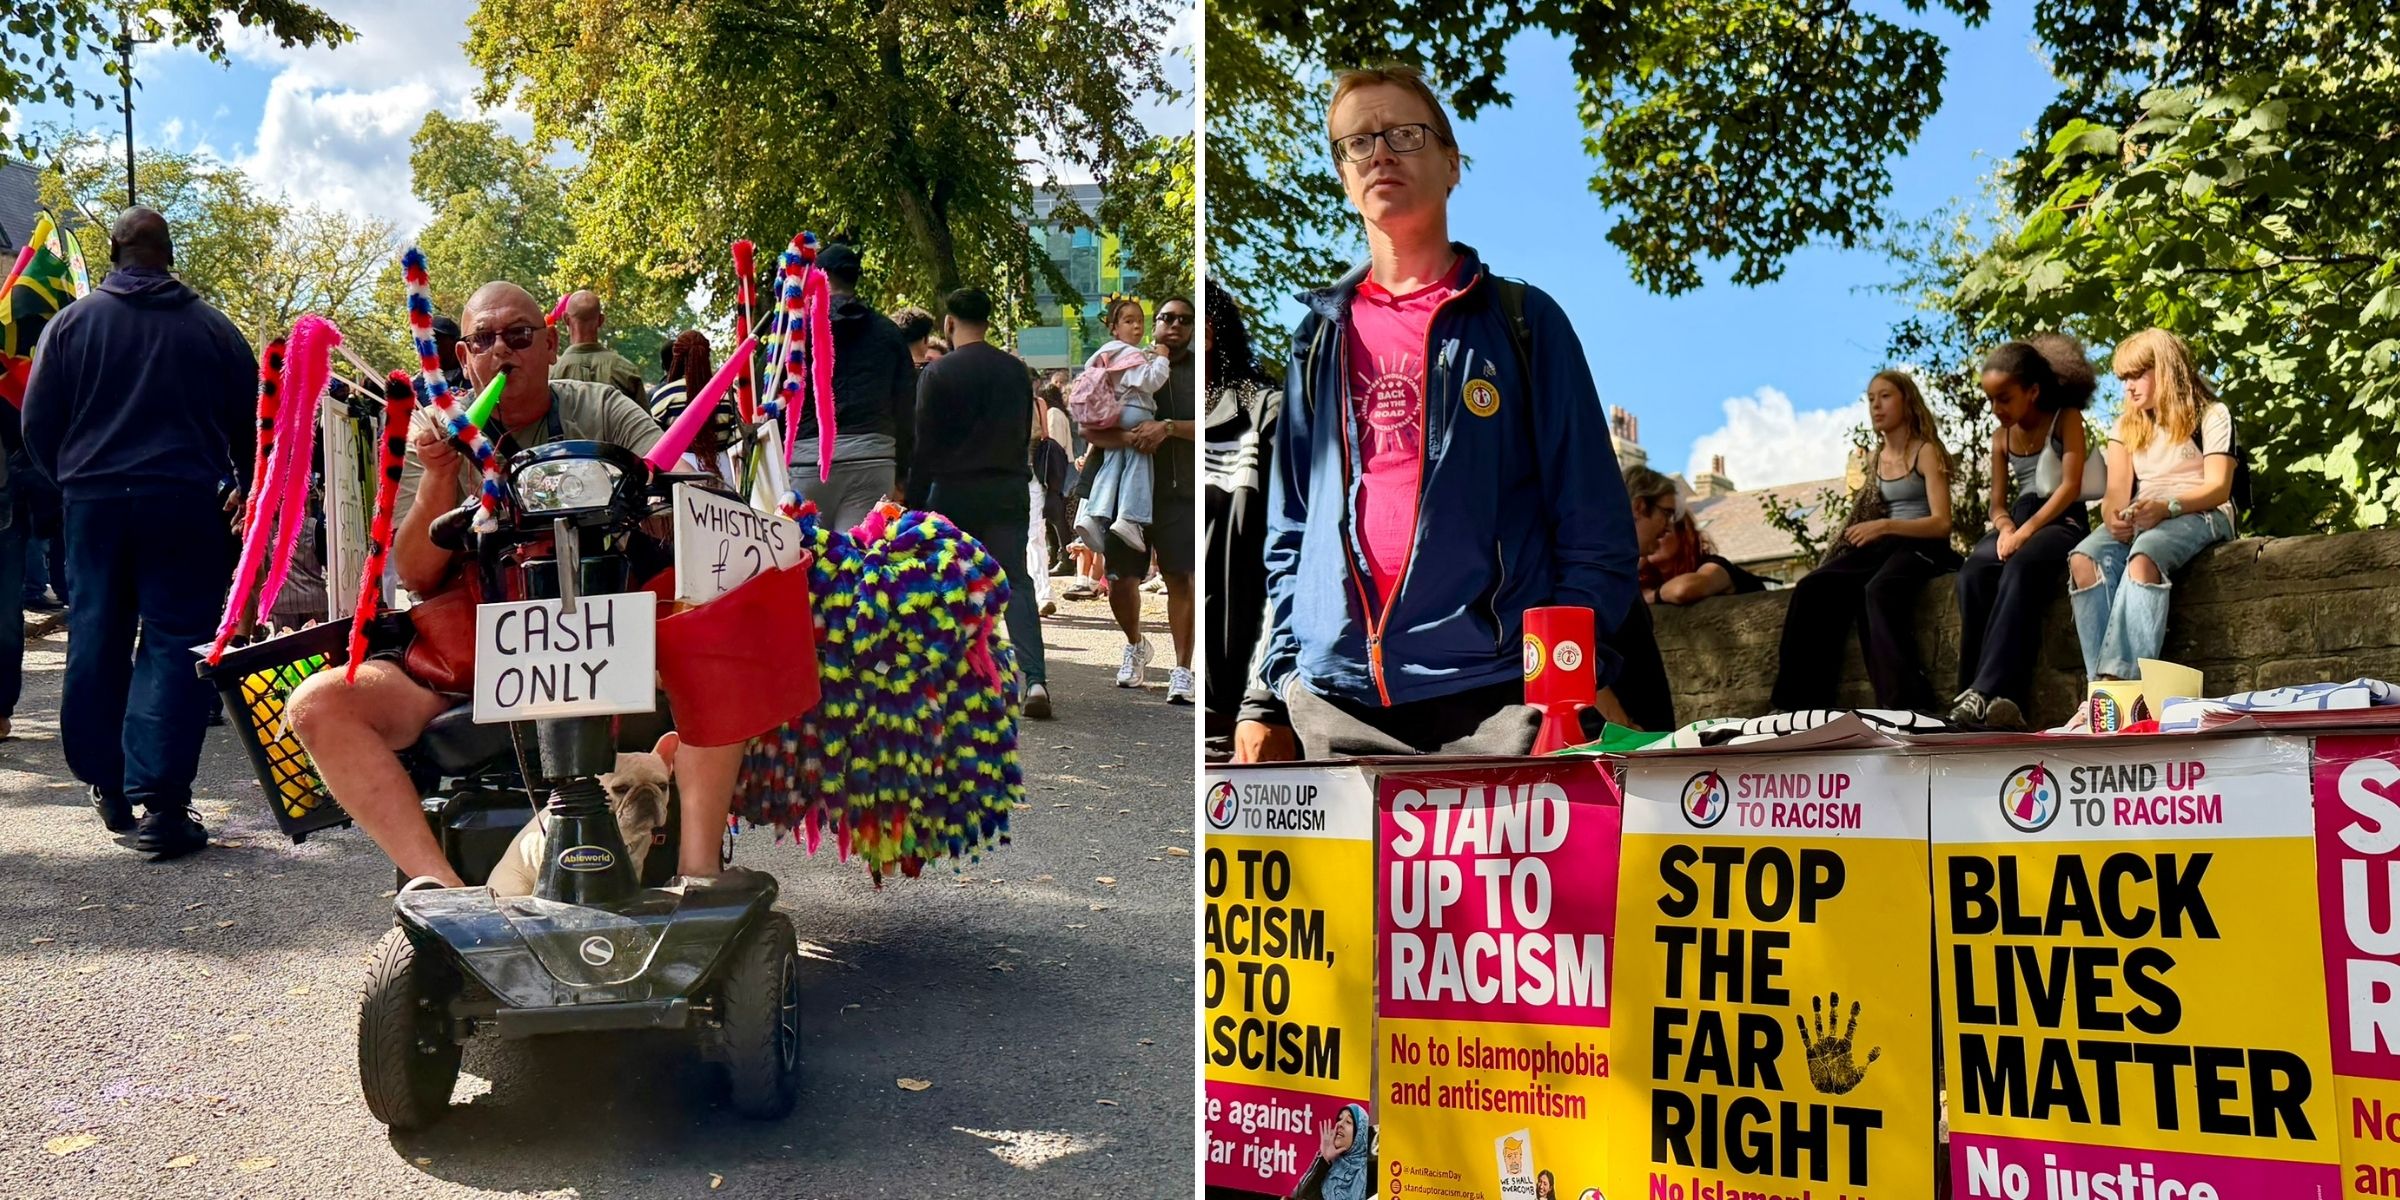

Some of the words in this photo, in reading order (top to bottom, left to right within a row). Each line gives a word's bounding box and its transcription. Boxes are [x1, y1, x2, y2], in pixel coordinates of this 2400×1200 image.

[1377, 389, 1406, 400] BACK
[1383, 373, 1409, 381] INDIAN
[1374, 409, 1406, 418] ROAD
[1376, 401, 1390, 409] ON
[1390, 399, 1406, 407] THE
[688, 497, 784, 551] WHISTLES
[496, 599, 614, 655] CASH
[496, 659, 609, 708] ONLY
[2099, 698, 2106, 713] UP
[2100, 715, 2106, 729] TO
[2106, 699, 2114, 731] STAND
[1243, 784, 1291, 805] STAND
[1296, 785, 1318, 806] UP
[1737, 773, 1811, 800] STAND
[1818, 773, 1851, 800] UP
[2069, 763, 2157, 794] STAND
[2166, 761, 2206, 791] UP
[1242, 808, 1262, 829] TO
[1266, 808, 1325, 831] RACISM
[1391, 782, 1570, 857] STAND
[1737, 802, 1766, 828] TO
[1771, 802, 1861, 829] RACISM
[2070, 799, 2106, 828] TO
[2114, 794, 2222, 826] RACISM
[564, 854, 610, 864] Ableworld
[1238, 850, 1291, 902] TO
[1391, 860, 1463, 930] UP
[1475, 857, 1552, 930] TO
[1656, 844, 1846, 924] STOP
[1948, 852, 2221, 939] BLACK
[1205, 903, 1334, 968] ACISM,
[1237, 961, 1290, 1015] TO
[1391, 932, 1607, 1008] RACISM
[1654, 925, 1790, 1007] THE
[1953, 943, 2182, 1035] LIVES
[1205, 1015, 1341, 1080] SCISM
[1391, 1033, 1421, 1066] No
[1428, 1036, 1450, 1068] to
[1457, 1035, 1609, 1080] Islamophobia
[1652, 1006, 1784, 1091] FAR
[1391, 1076, 1431, 1106] and
[1438, 1078, 1586, 1120] antisemitism
[1958, 1032, 2318, 1142] MATTER
[1229, 1097, 1313, 1135] against
[1651, 1088, 1883, 1187] RIGHT
[1205, 1130, 1235, 1164] far
[1243, 1137, 1297, 1178] right
[1404, 1167, 1462, 1181] @AntiRacismDay
[1966, 1145, 2030, 1200] No
[1404, 1183, 1485, 1200] standuptoracism.org.uk
[1512, 1176, 1533, 1185] SHALL
[1650, 1172, 1684, 1200] No
